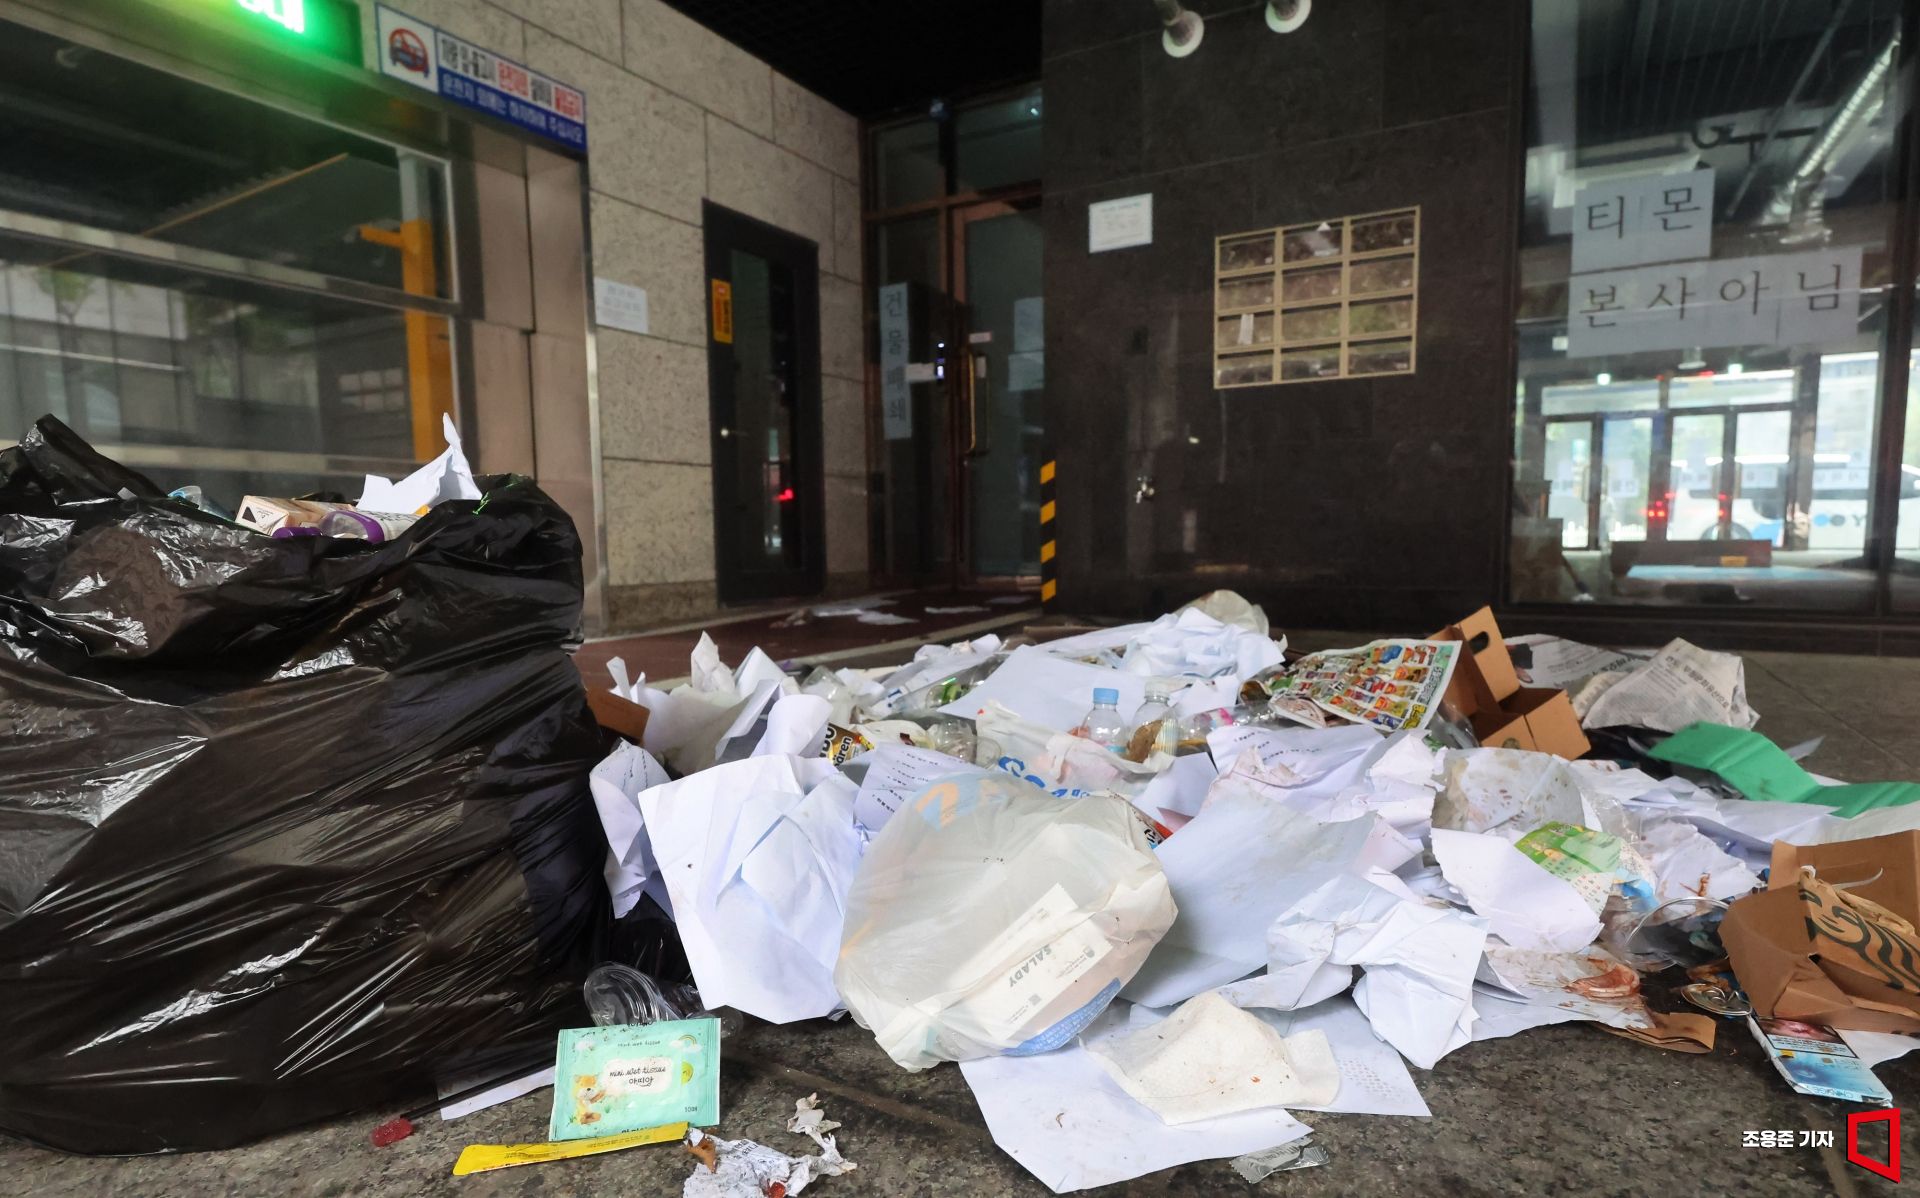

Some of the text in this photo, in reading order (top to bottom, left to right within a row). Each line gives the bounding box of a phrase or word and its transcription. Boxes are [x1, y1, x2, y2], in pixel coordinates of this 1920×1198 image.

[1586, 186, 1702, 239] 티몬
[1009, 944, 1053, 988] SALADY
[609, 1069, 625, 1078] mini
[641, 1066, 667, 1075] tissue
